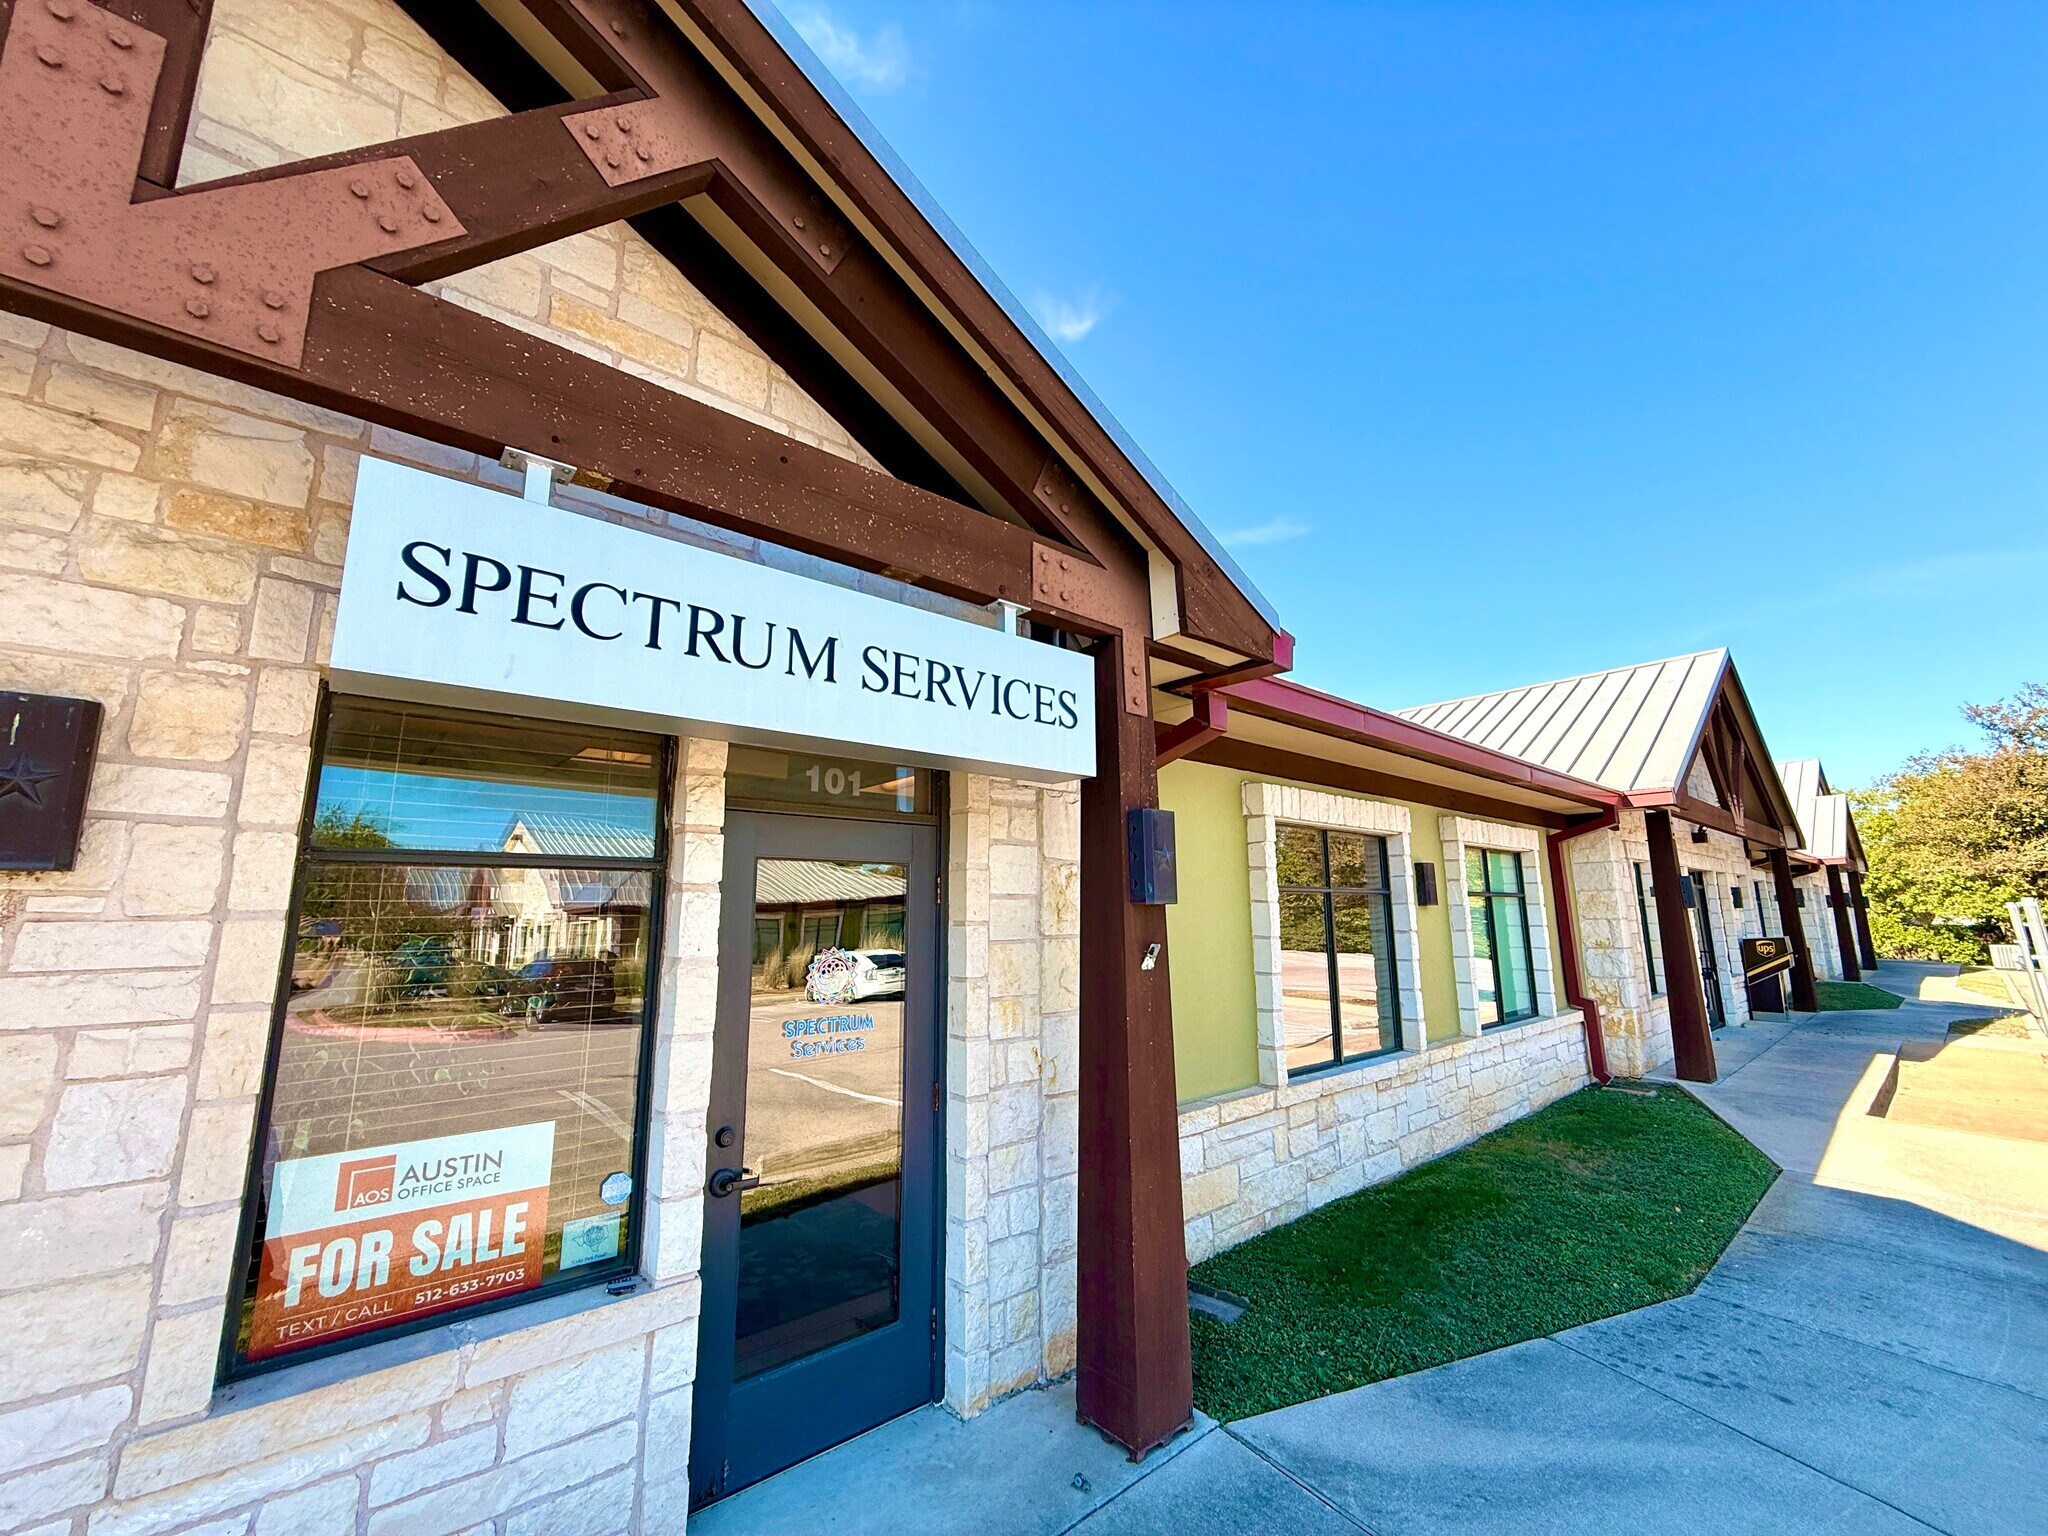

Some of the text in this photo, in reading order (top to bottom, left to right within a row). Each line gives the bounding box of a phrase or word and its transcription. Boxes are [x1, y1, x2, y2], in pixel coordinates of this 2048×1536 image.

[396, 541, 1079, 730] SPECTRUM SERVICES
[806, 765, 860, 796] 101
[1757, 945, 1774, 955] ups
[784, 1014, 874, 1038] SPECTRUM
[793, 1037, 866, 1058] Services
[399, 1150, 503, 1185] AUSTIN
[353, 1187, 390, 1207] AOS
[397, 1171, 501, 1200] OFFICE SPACE
[284, 1201, 529, 1309] FOR SALE
[414, 1267, 526, 1305] 512-633-7703
[277, 1315, 329, 1340] TEXT
[345, 1301, 394, 1322] CALL
